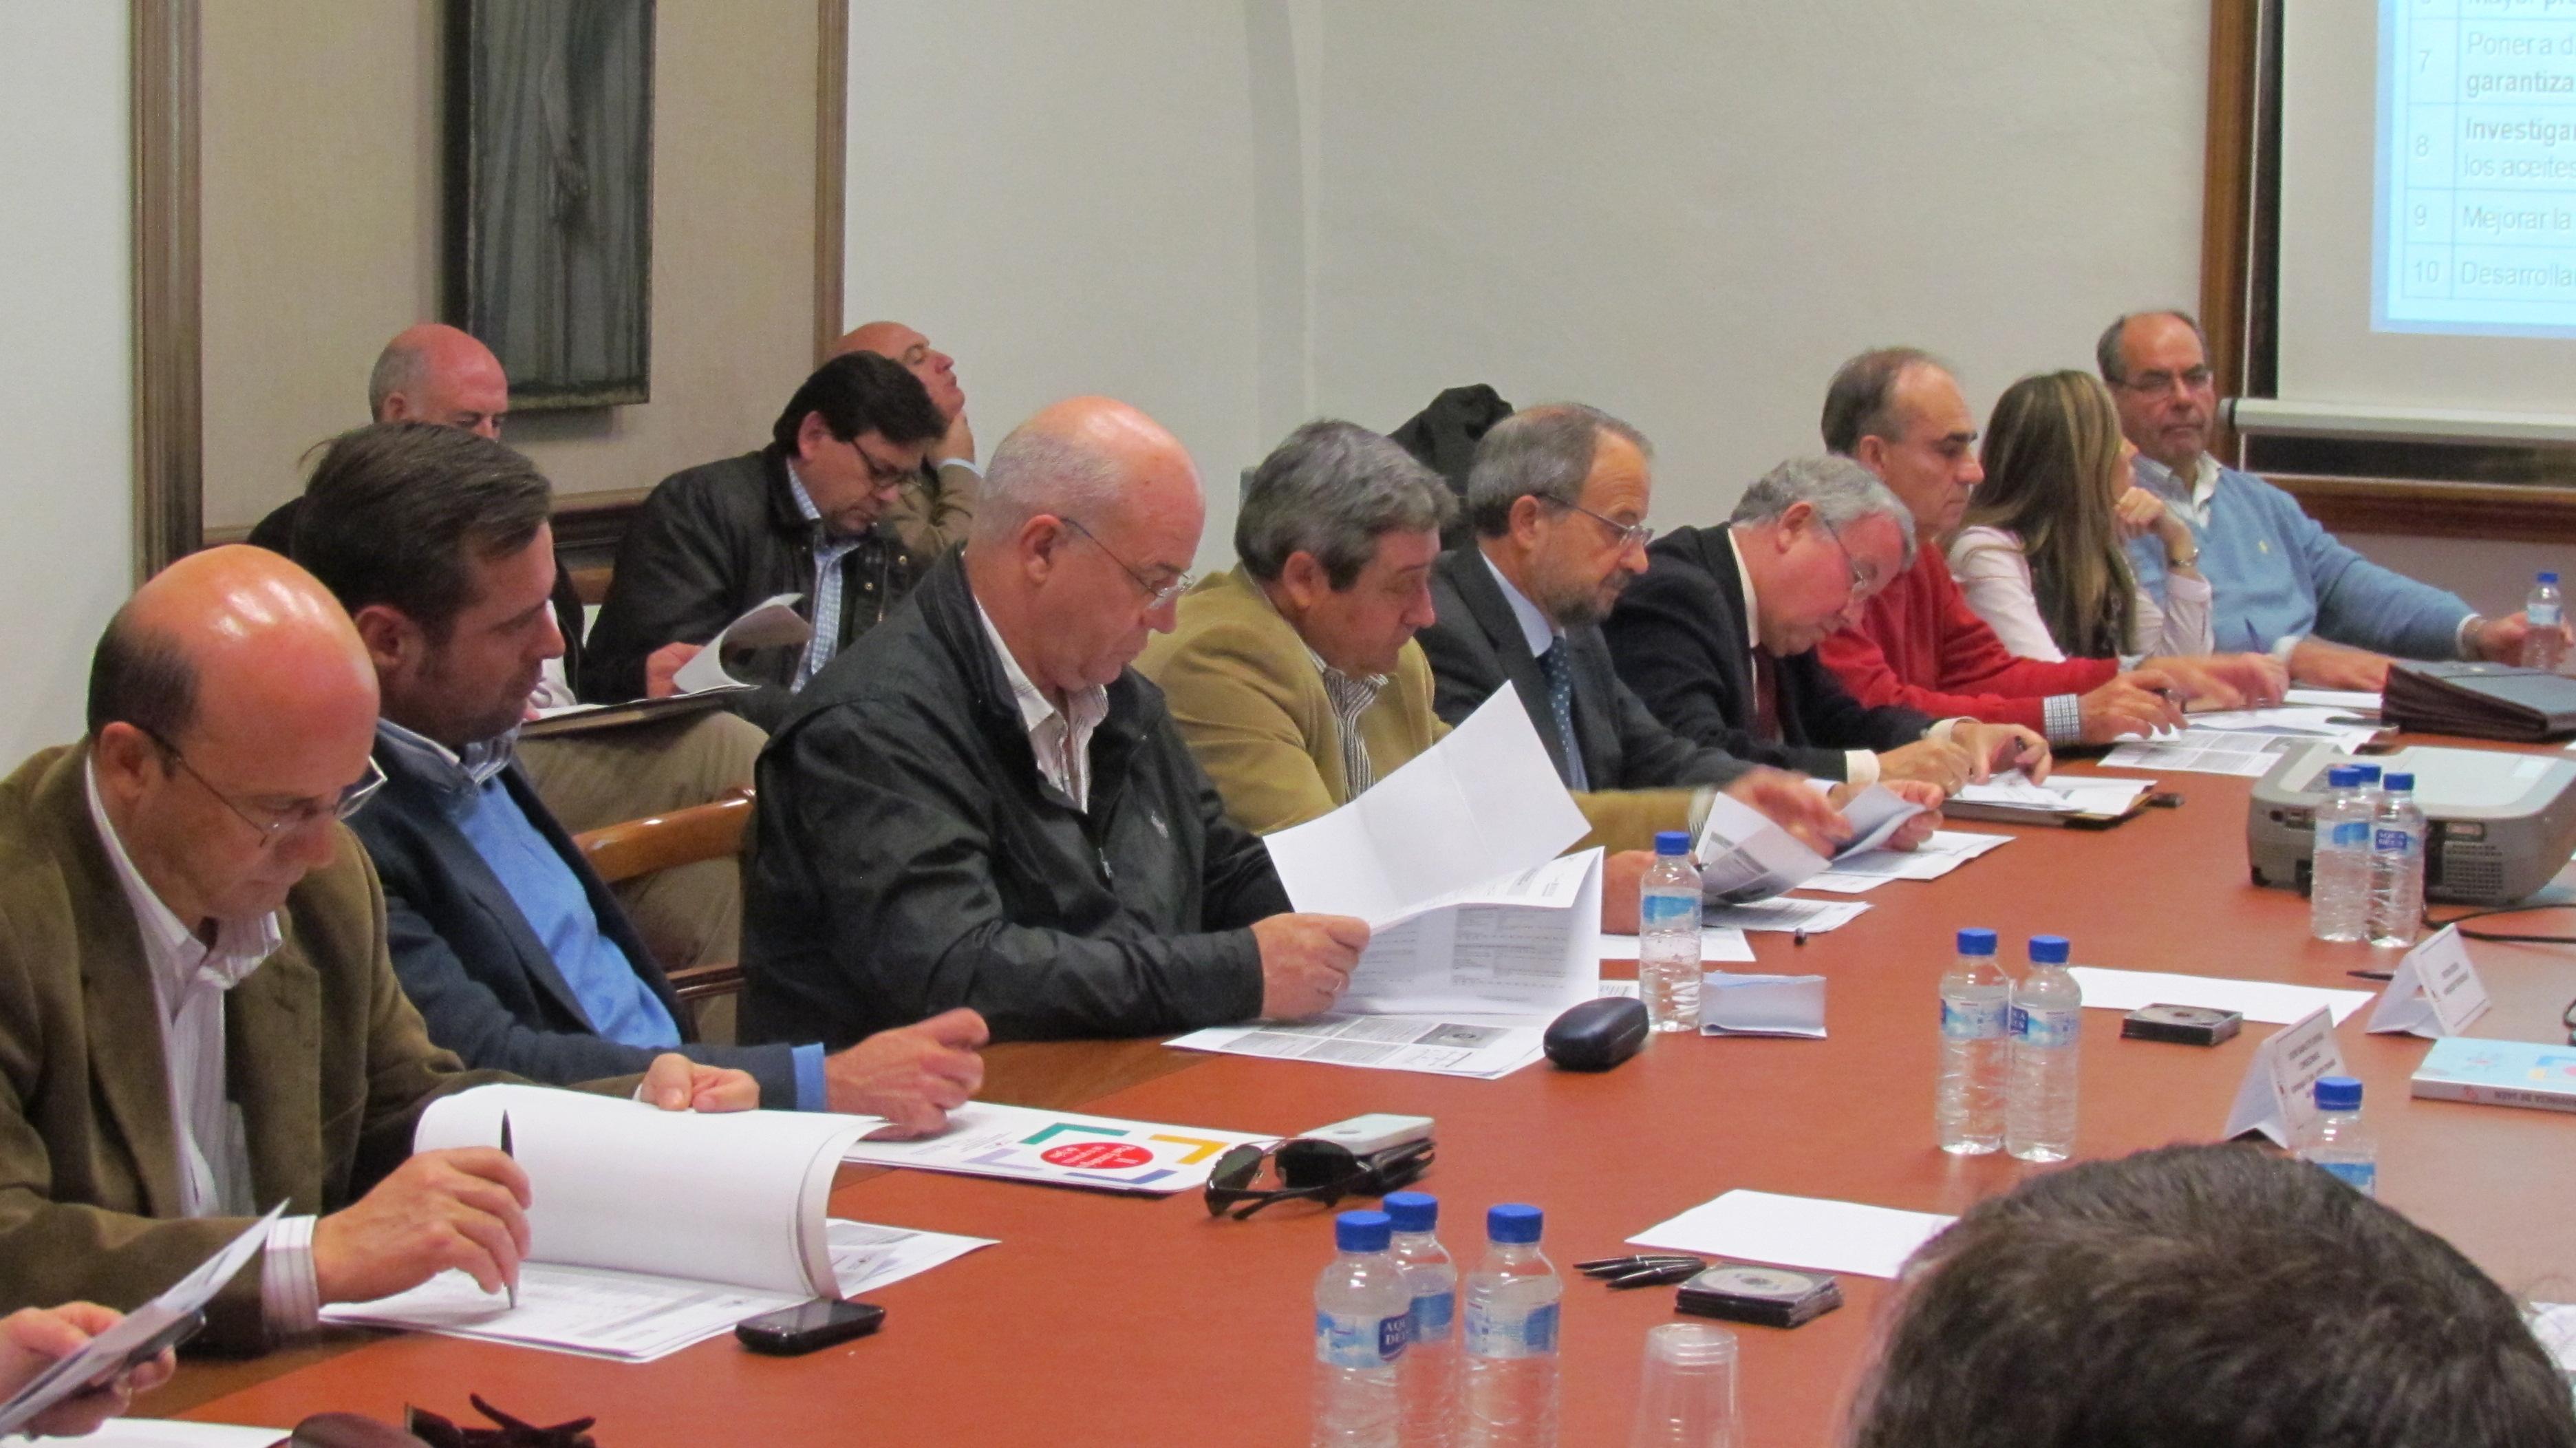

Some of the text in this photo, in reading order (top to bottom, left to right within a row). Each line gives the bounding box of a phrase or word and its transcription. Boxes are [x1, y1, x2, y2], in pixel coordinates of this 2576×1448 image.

[2467, 31, 2535, 55] Poner
[2540, 37, 2552, 55] a
[2418, 50, 2431, 74] 7
[2467, 71, 2573, 98] garantiza
[2416, 135, 2428, 157] 8
[2464, 153, 2576, 178] los aceites
[2414, 204, 2427, 226] 9
[2462, 206, 2570, 235] Mejorar la
[2414, 260, 2439, 283] 10
[2461, 261, 2576, 287] Desarrolla
